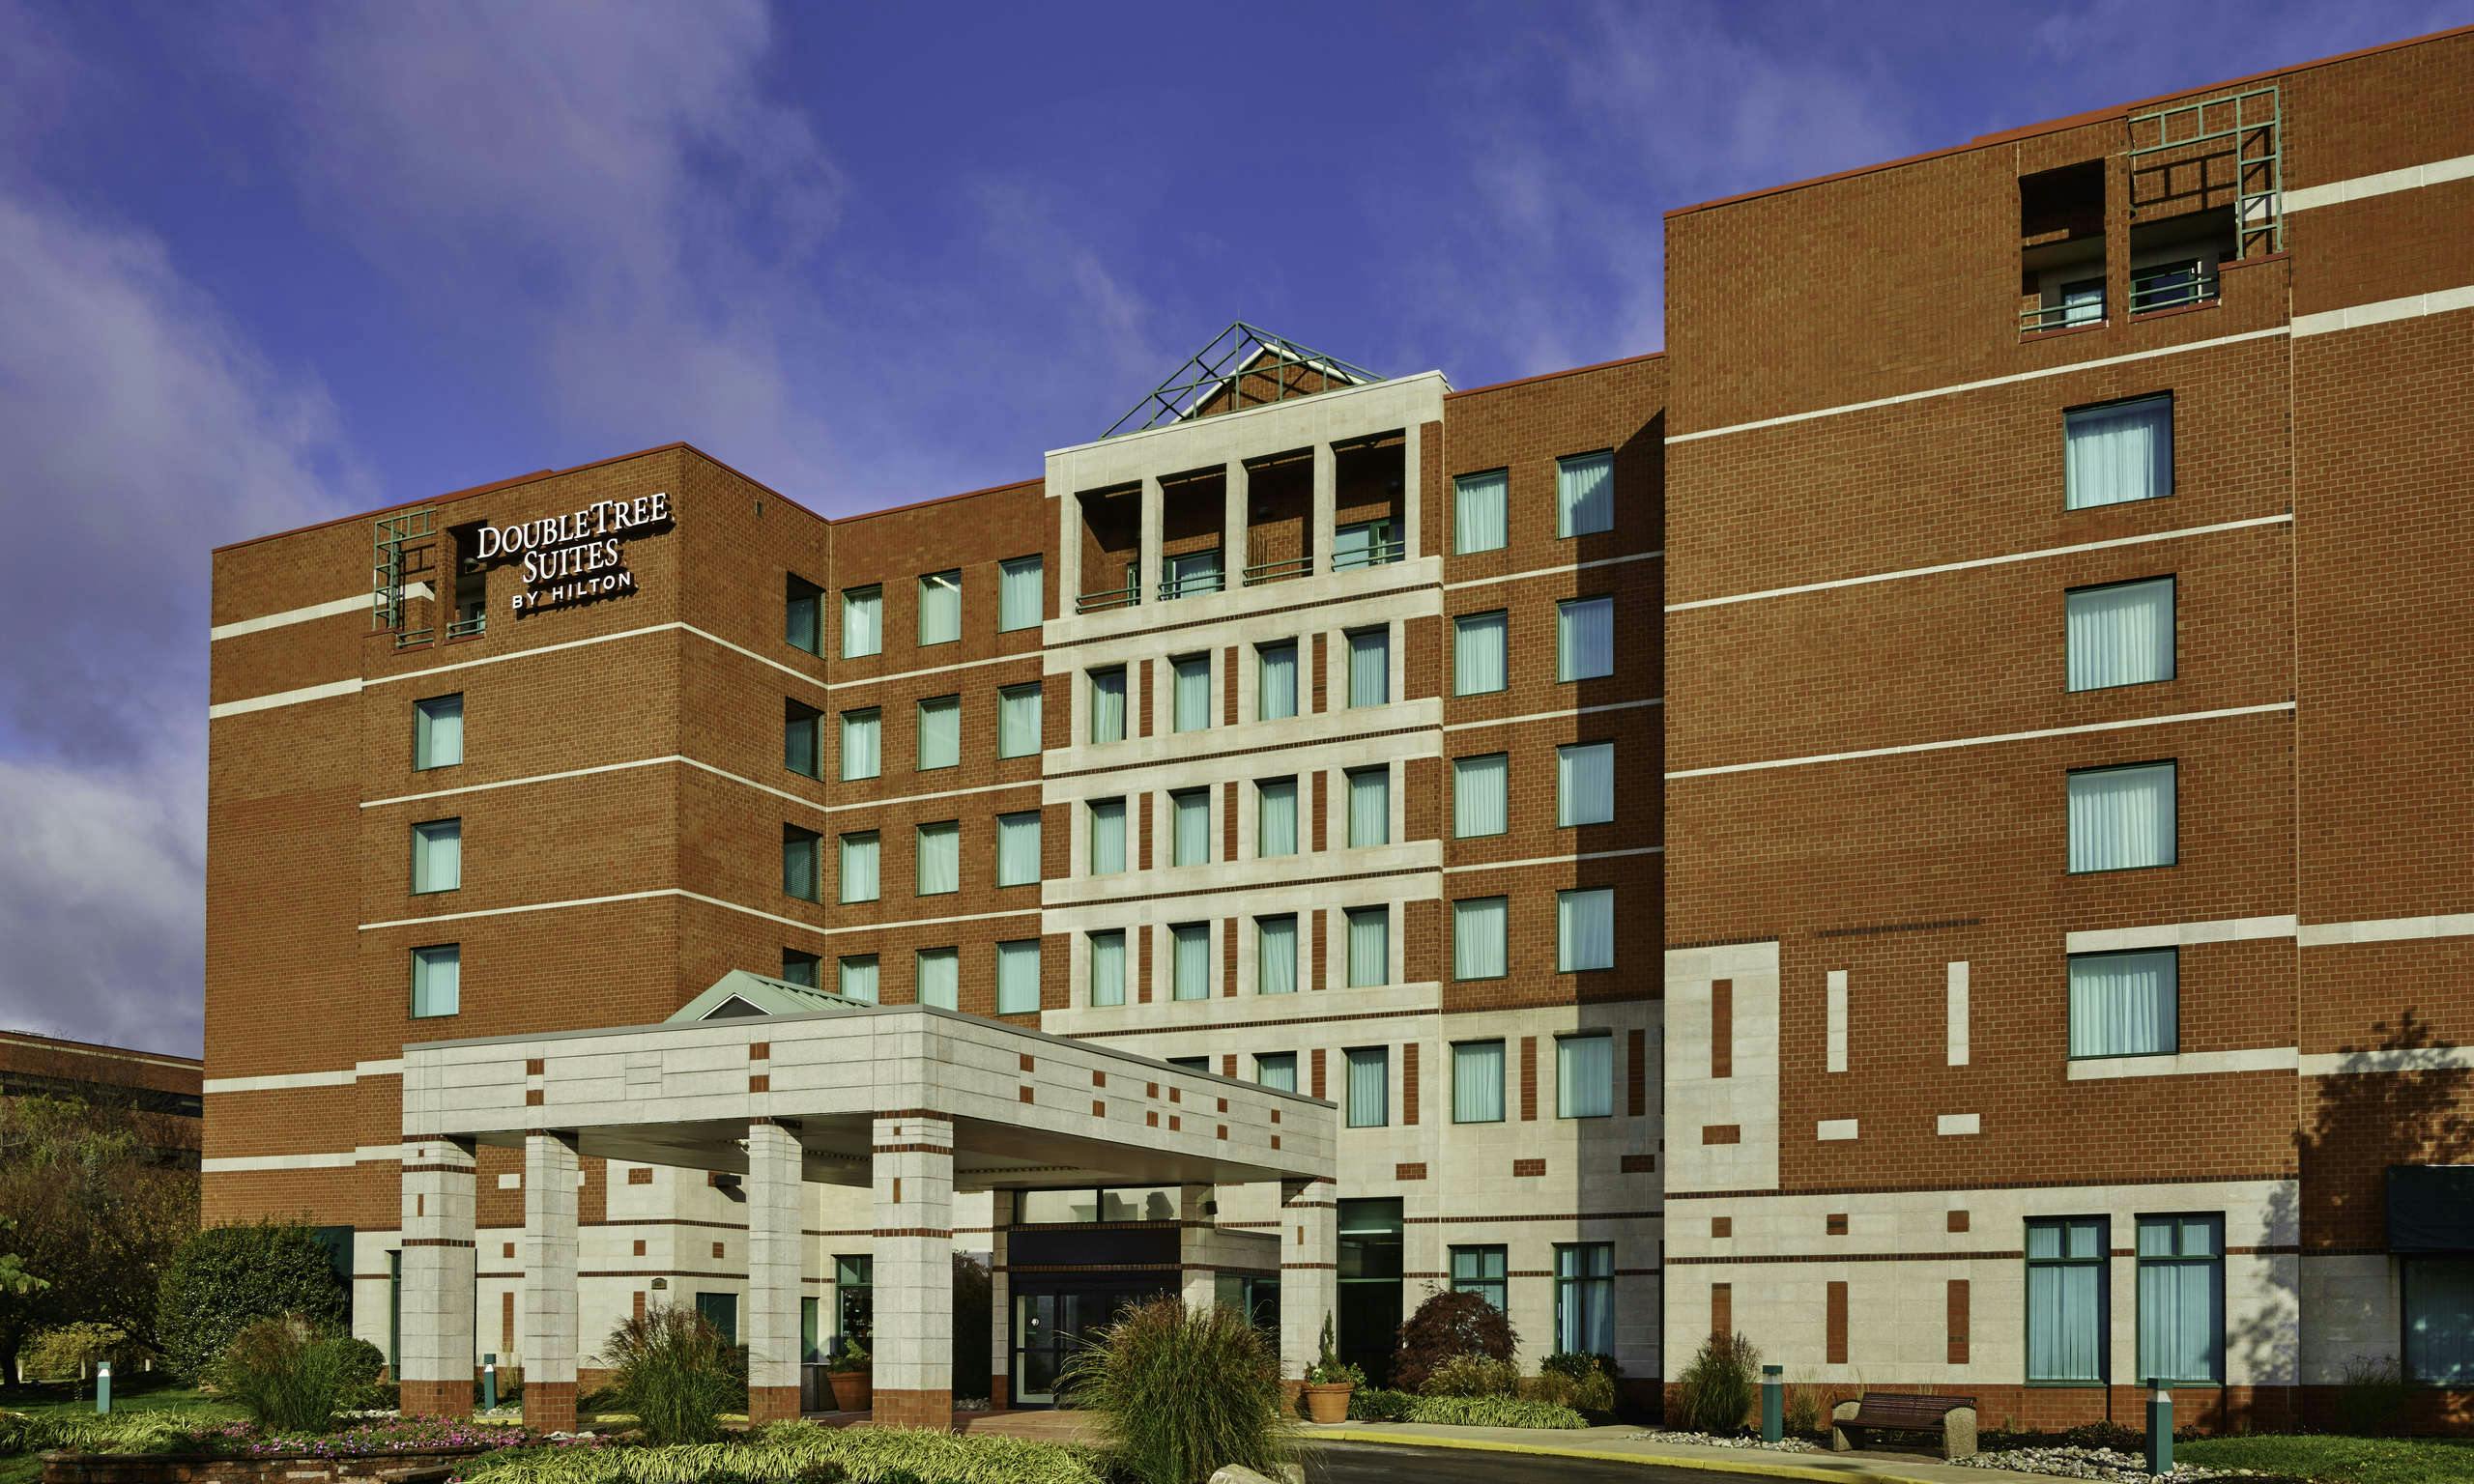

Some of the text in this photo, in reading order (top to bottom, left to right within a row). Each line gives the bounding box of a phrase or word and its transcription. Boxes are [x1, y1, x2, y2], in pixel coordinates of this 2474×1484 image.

[522, 538, 618, 584] SUITES
[512, 571, 631, 610] BY HILTON
